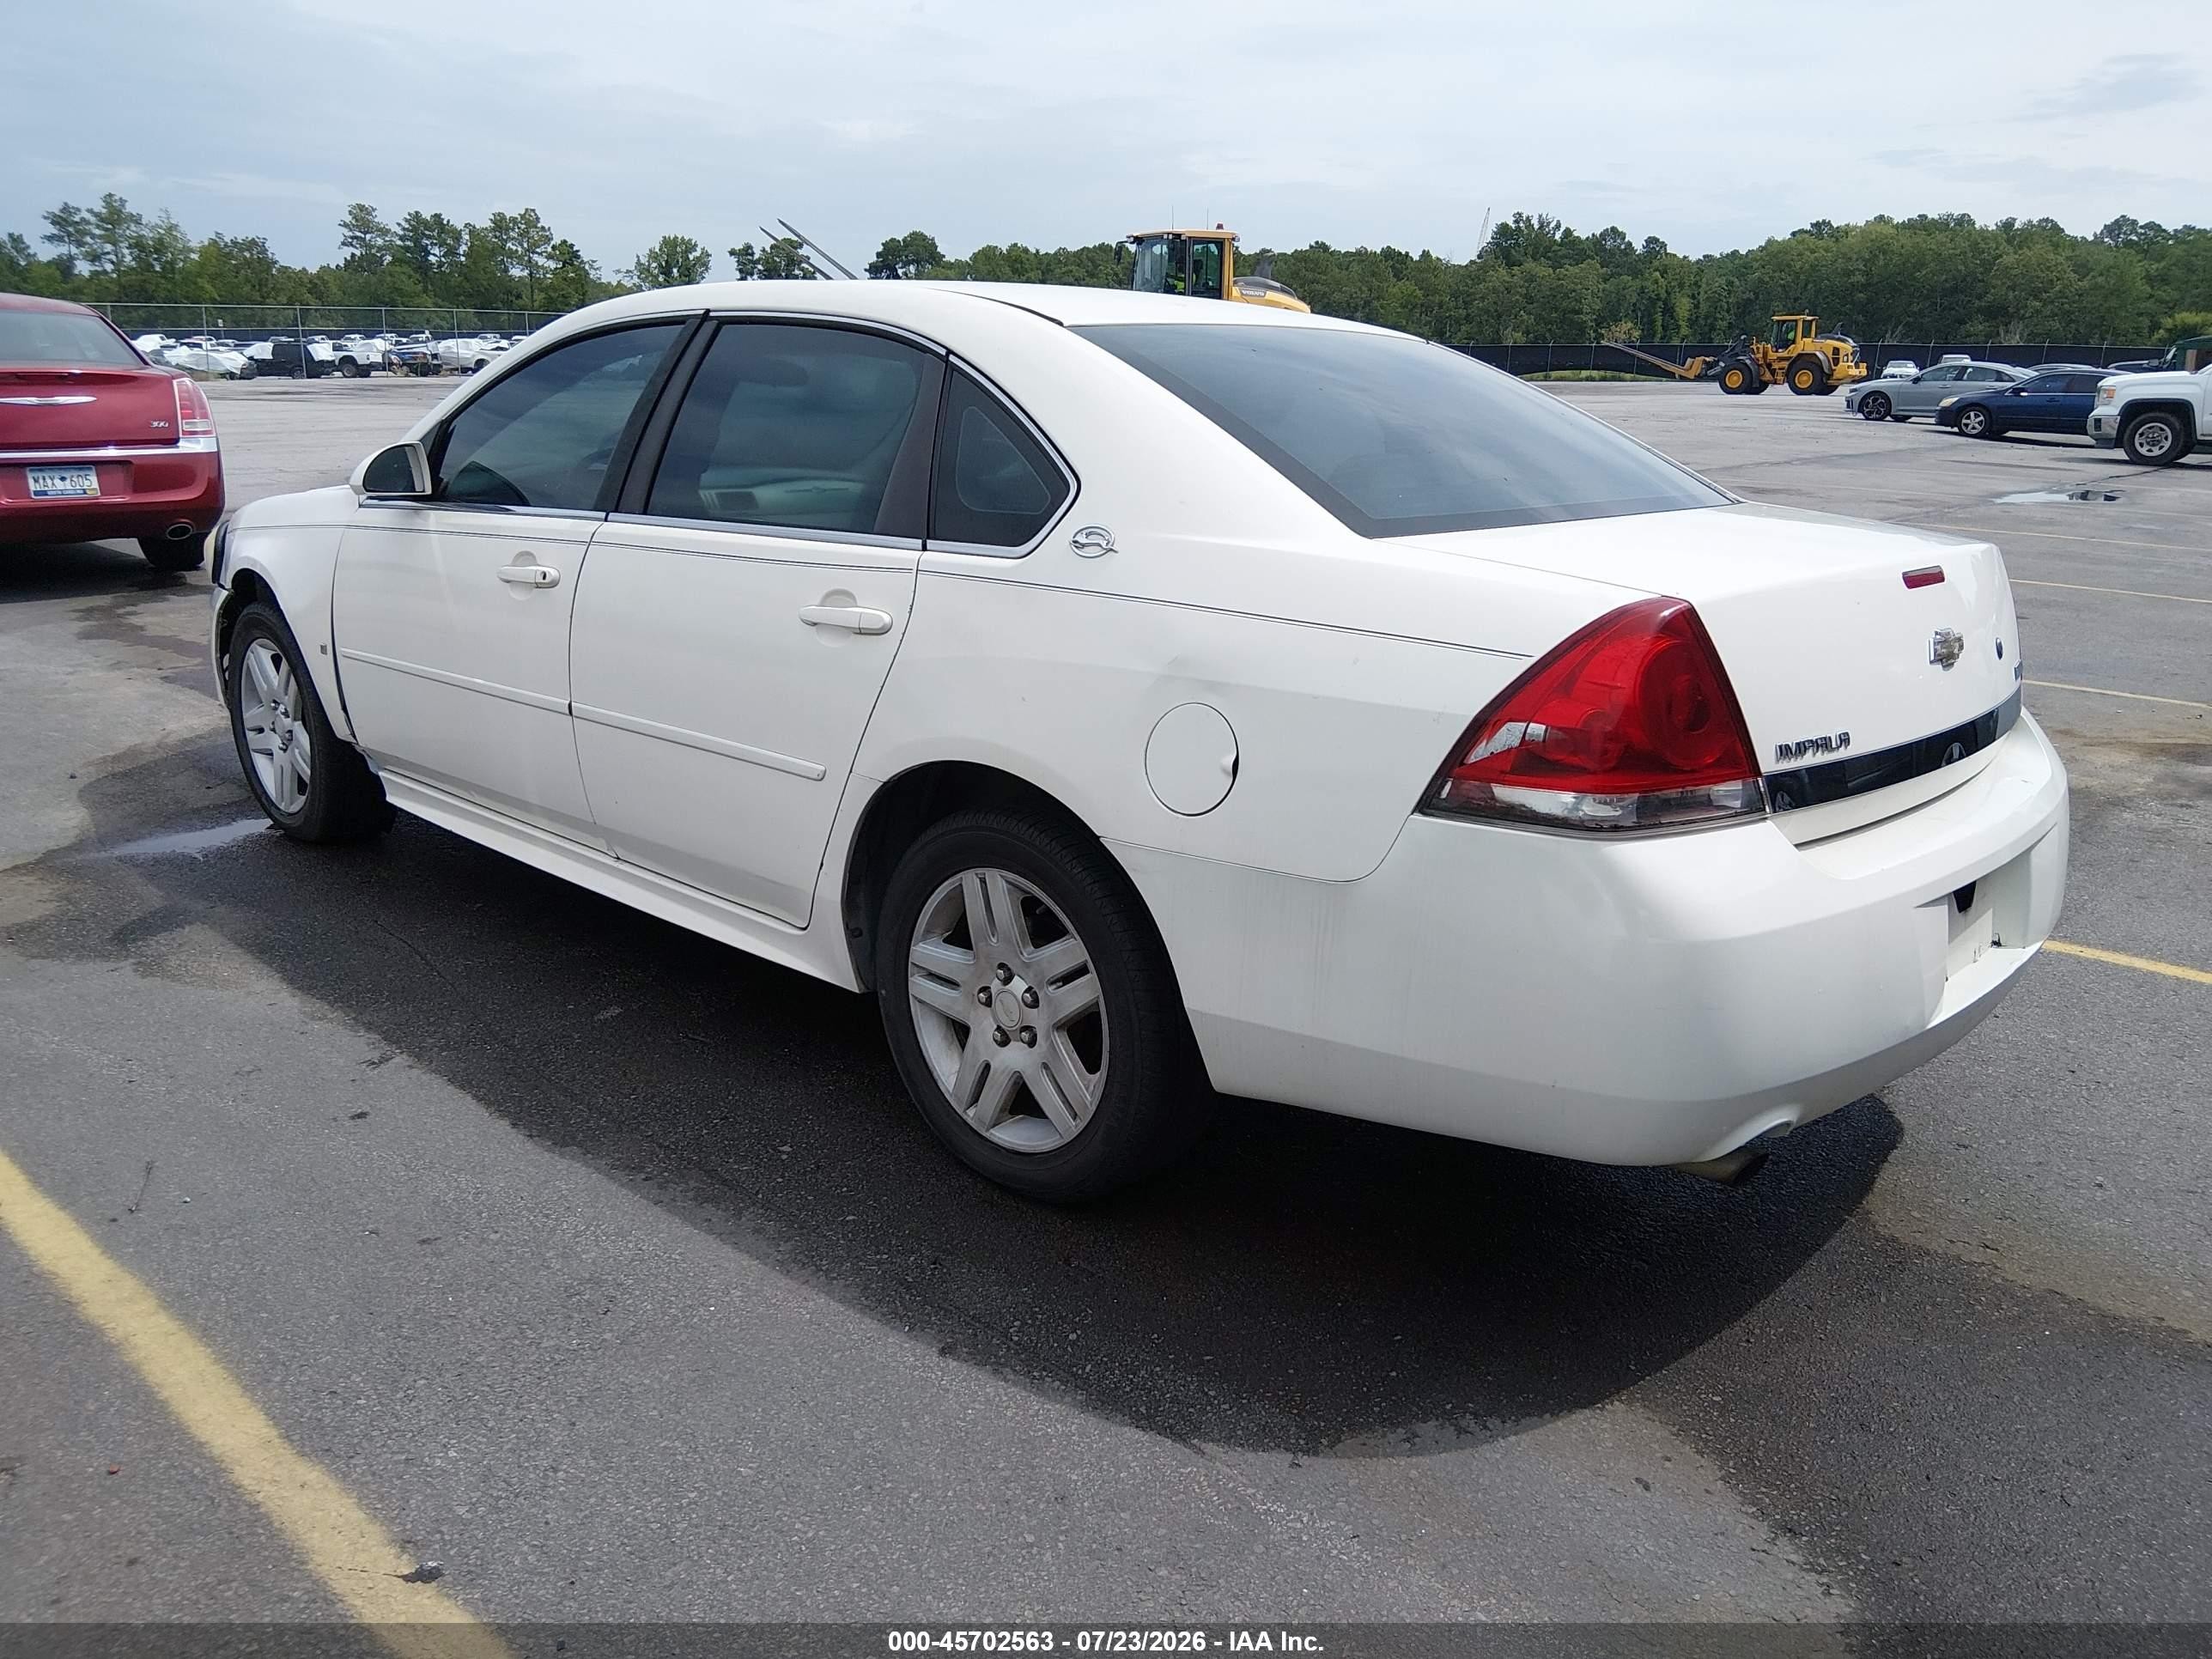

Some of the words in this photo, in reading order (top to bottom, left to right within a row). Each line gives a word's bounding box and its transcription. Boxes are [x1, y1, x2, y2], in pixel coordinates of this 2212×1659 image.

[32, 474, 58, 489] MAX
[70, 473, 93, 489] 605
[1774, 731, 1850, 763] IMPALA
